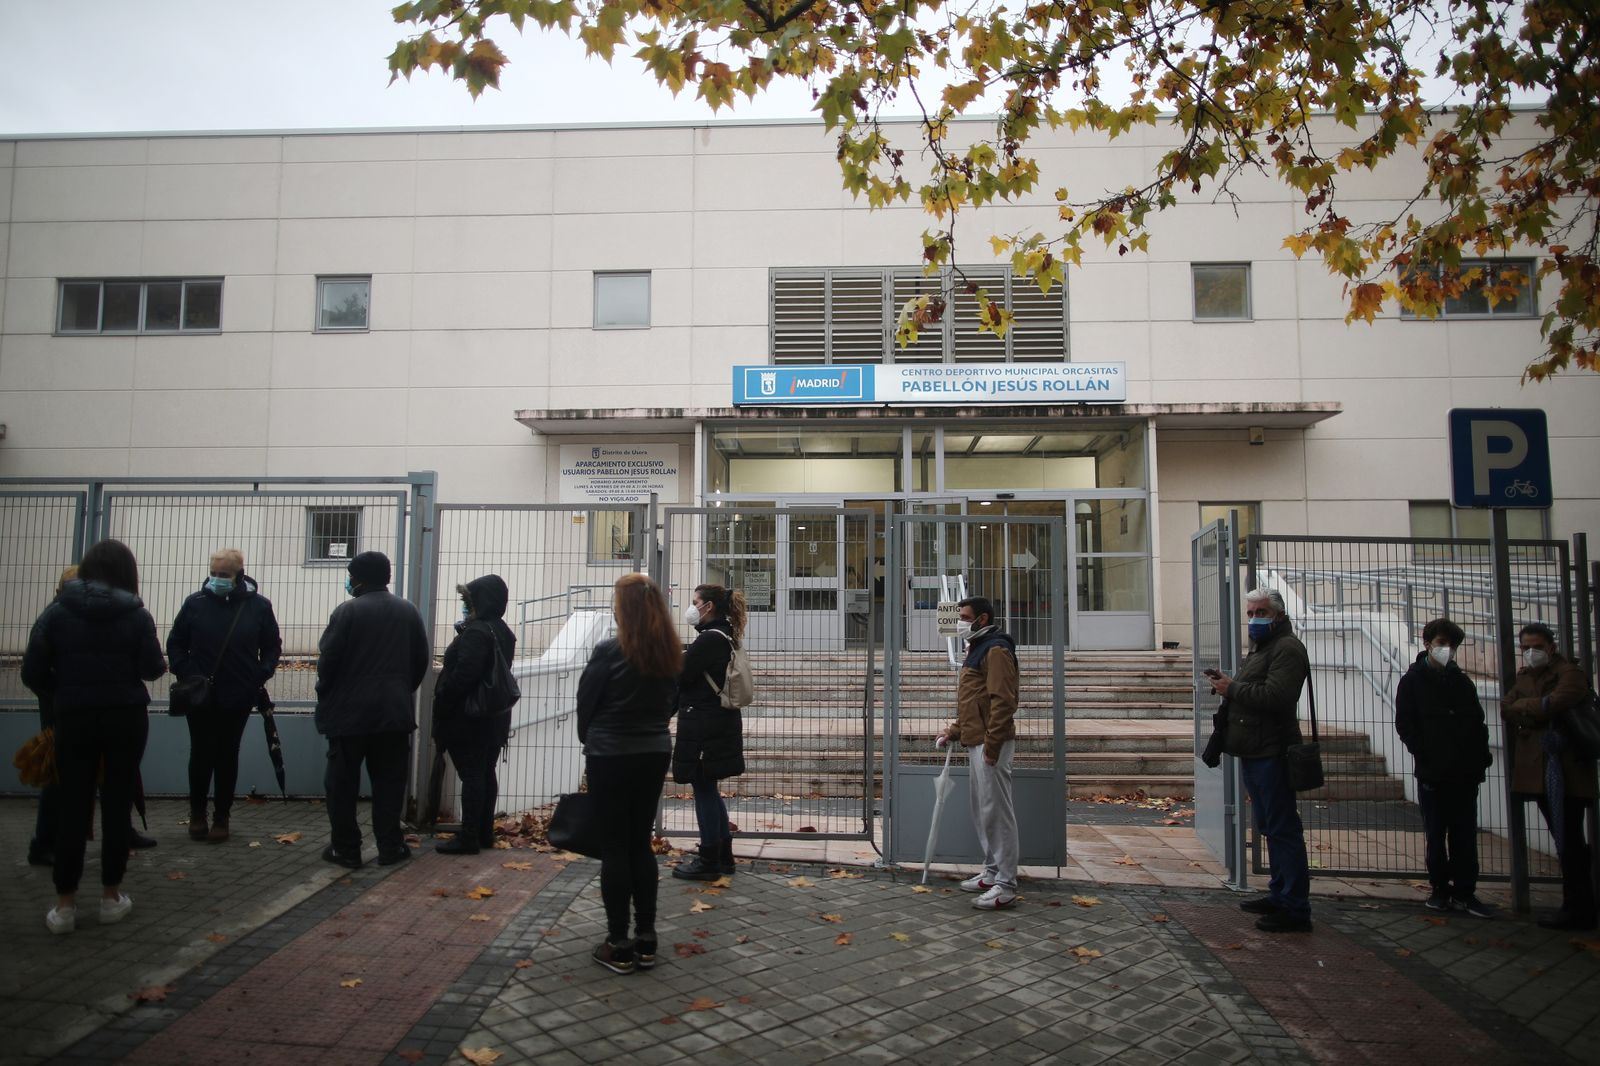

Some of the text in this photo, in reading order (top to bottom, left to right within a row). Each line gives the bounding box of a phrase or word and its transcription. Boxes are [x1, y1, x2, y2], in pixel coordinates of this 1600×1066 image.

[901, 367, 1119, 377] CENTRO DEPORTIVO MUNICIPAL ORCASITAS
[902, 376, 1110, 394] PABELLÓN JESÚS ROLLÁN
[1470, 420, 1528, 496] P
